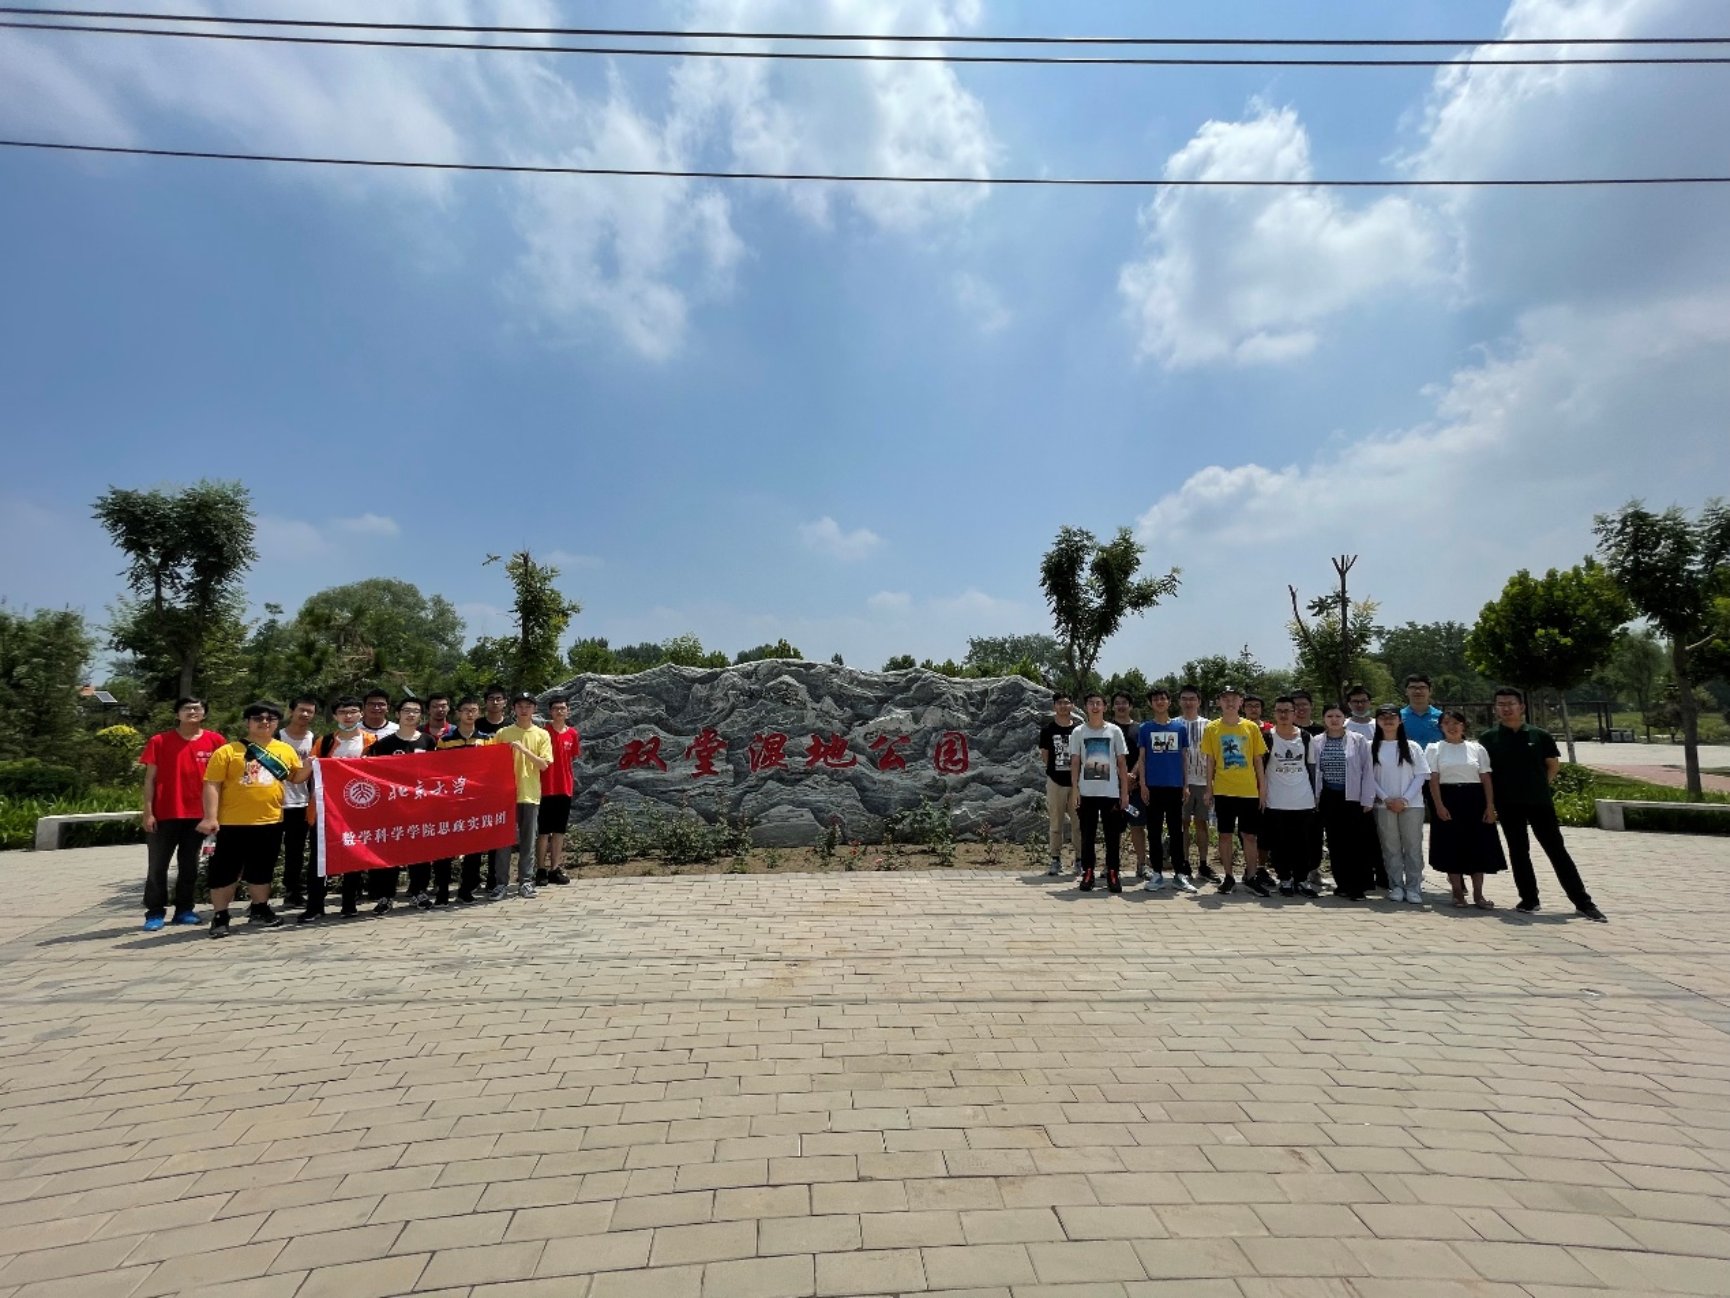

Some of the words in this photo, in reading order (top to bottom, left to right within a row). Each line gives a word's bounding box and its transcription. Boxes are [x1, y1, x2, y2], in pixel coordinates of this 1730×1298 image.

[388, 775, 467, 801] 北京大学
[341, 810, 507, 847] 数学科学学院思政实践团
